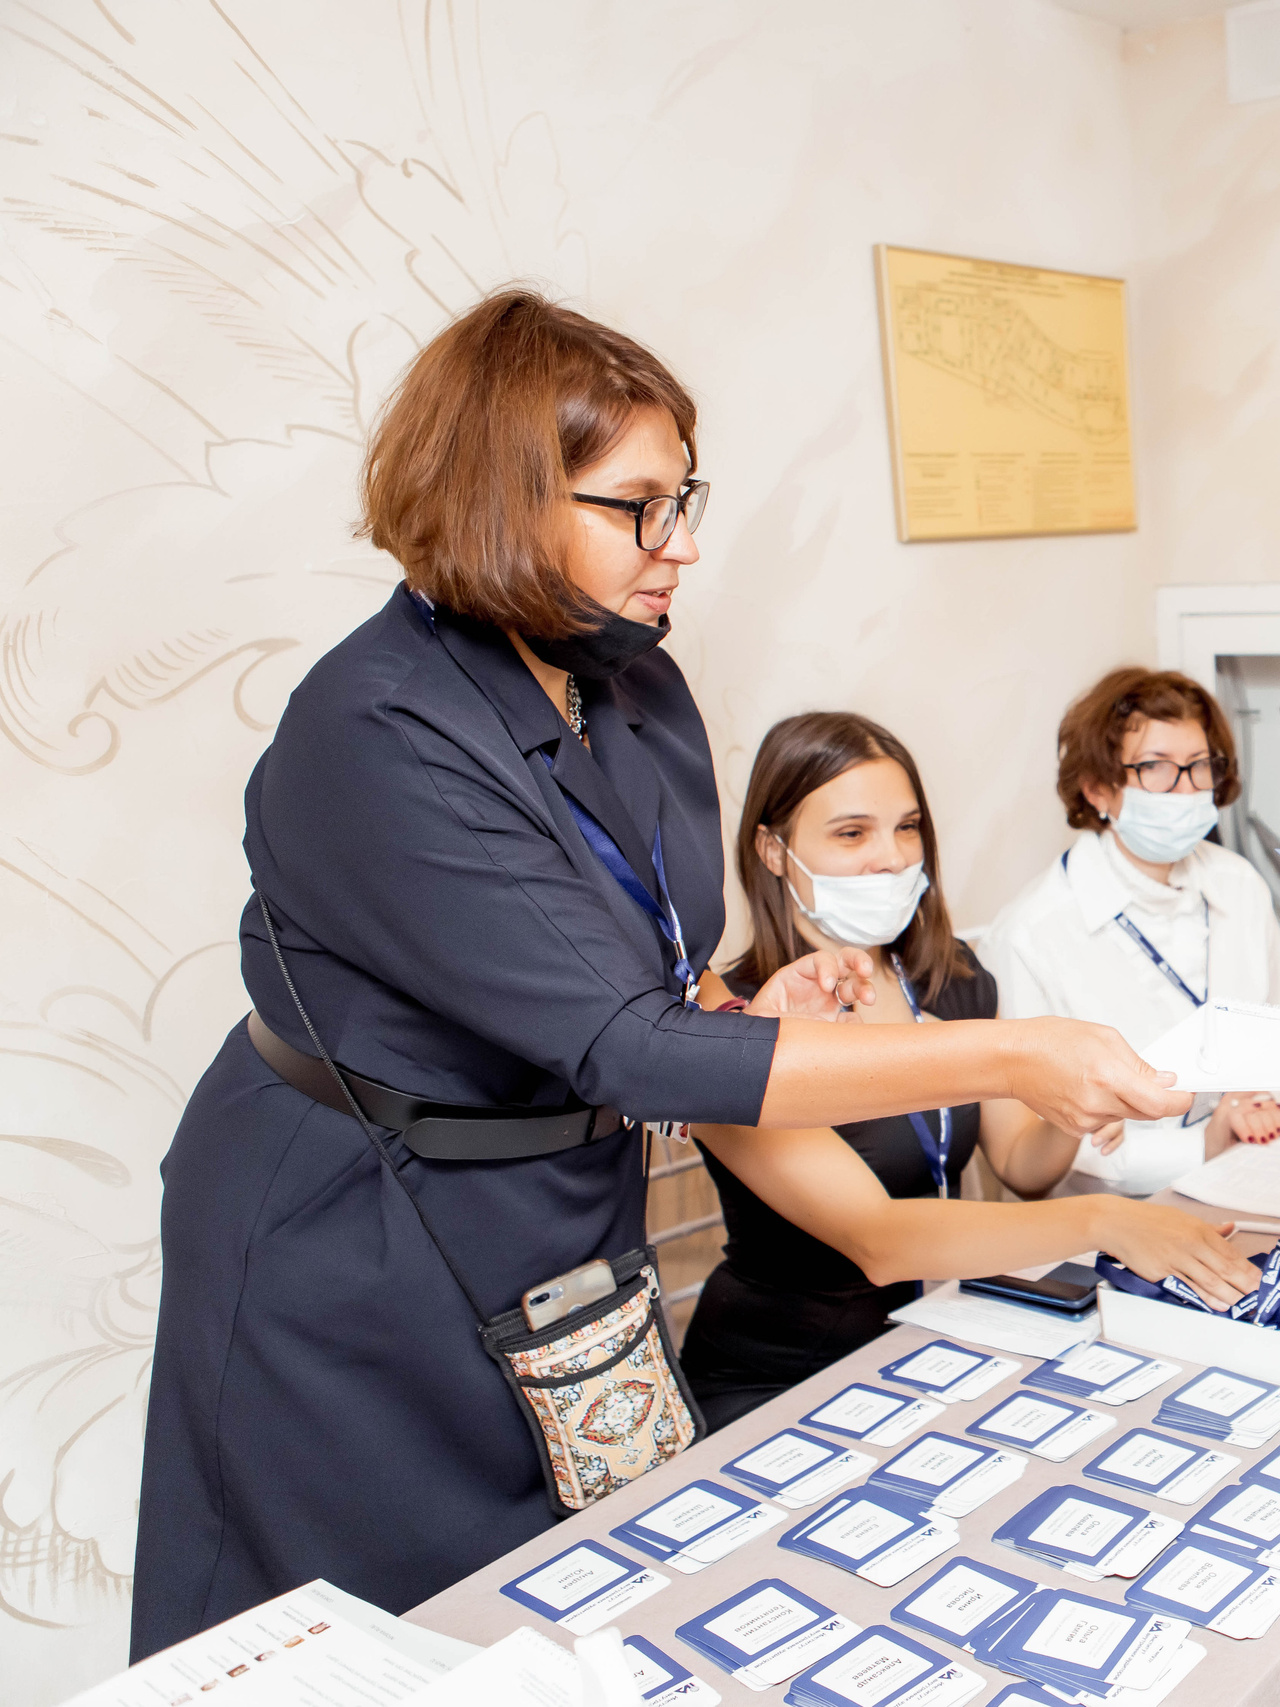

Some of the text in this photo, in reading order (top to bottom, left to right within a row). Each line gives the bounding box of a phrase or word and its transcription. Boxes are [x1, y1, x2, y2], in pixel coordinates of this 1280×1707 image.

[1132, 1448, 1157, 1467] Иванова
[1144, 1453, 1164, 1467] Ирина
[674, 1504, 715, 1528] Александр
[1259, 1506, 1280, 1521] Елена
[839, 1515, 877, 1539] Сидорова
[854, 1523, 879, 1538] Елена
[1080, 1520, 1100, 1536] Ольга
[901, 1537, 926, 1553] Институт
[557, 1568, 584, 1583] Юдин
[561, 1570, 594, 1589] Андрей
[1177, 1562, 1213, 1590] Васильева
[1194, 1571, 1217, 1589] Олеся
[596, 1582, 630, 1604] внутренних
[607, 1584, 636, 1602] Институт
[945, 1586, 975, 1608] Лисова
[957, 1592, 982, 1611] Ирина
[1248, 1587, 1268, 1604] Институт
[564, 1603, 597, 1624] аудиторов
[742, 1608, 793, 1637] Константин
[797, 1632, 826, 1649] Институт
[1078, 1624, 1099, 1643] Ольга
[753, 1629, 820, 1669] внутренних аудиторов
[1141, 1633, 1159, 1654] Институт
[1113, 1632, 1150, 1681] внутренних аудиторов
[851, 1656, 889, 1680] Матвеев
[856, 1658, 901, 1688] Александр
[905, 1678, 938, 1701] внутренних
[916, 1681, 944, 1700] Институт
